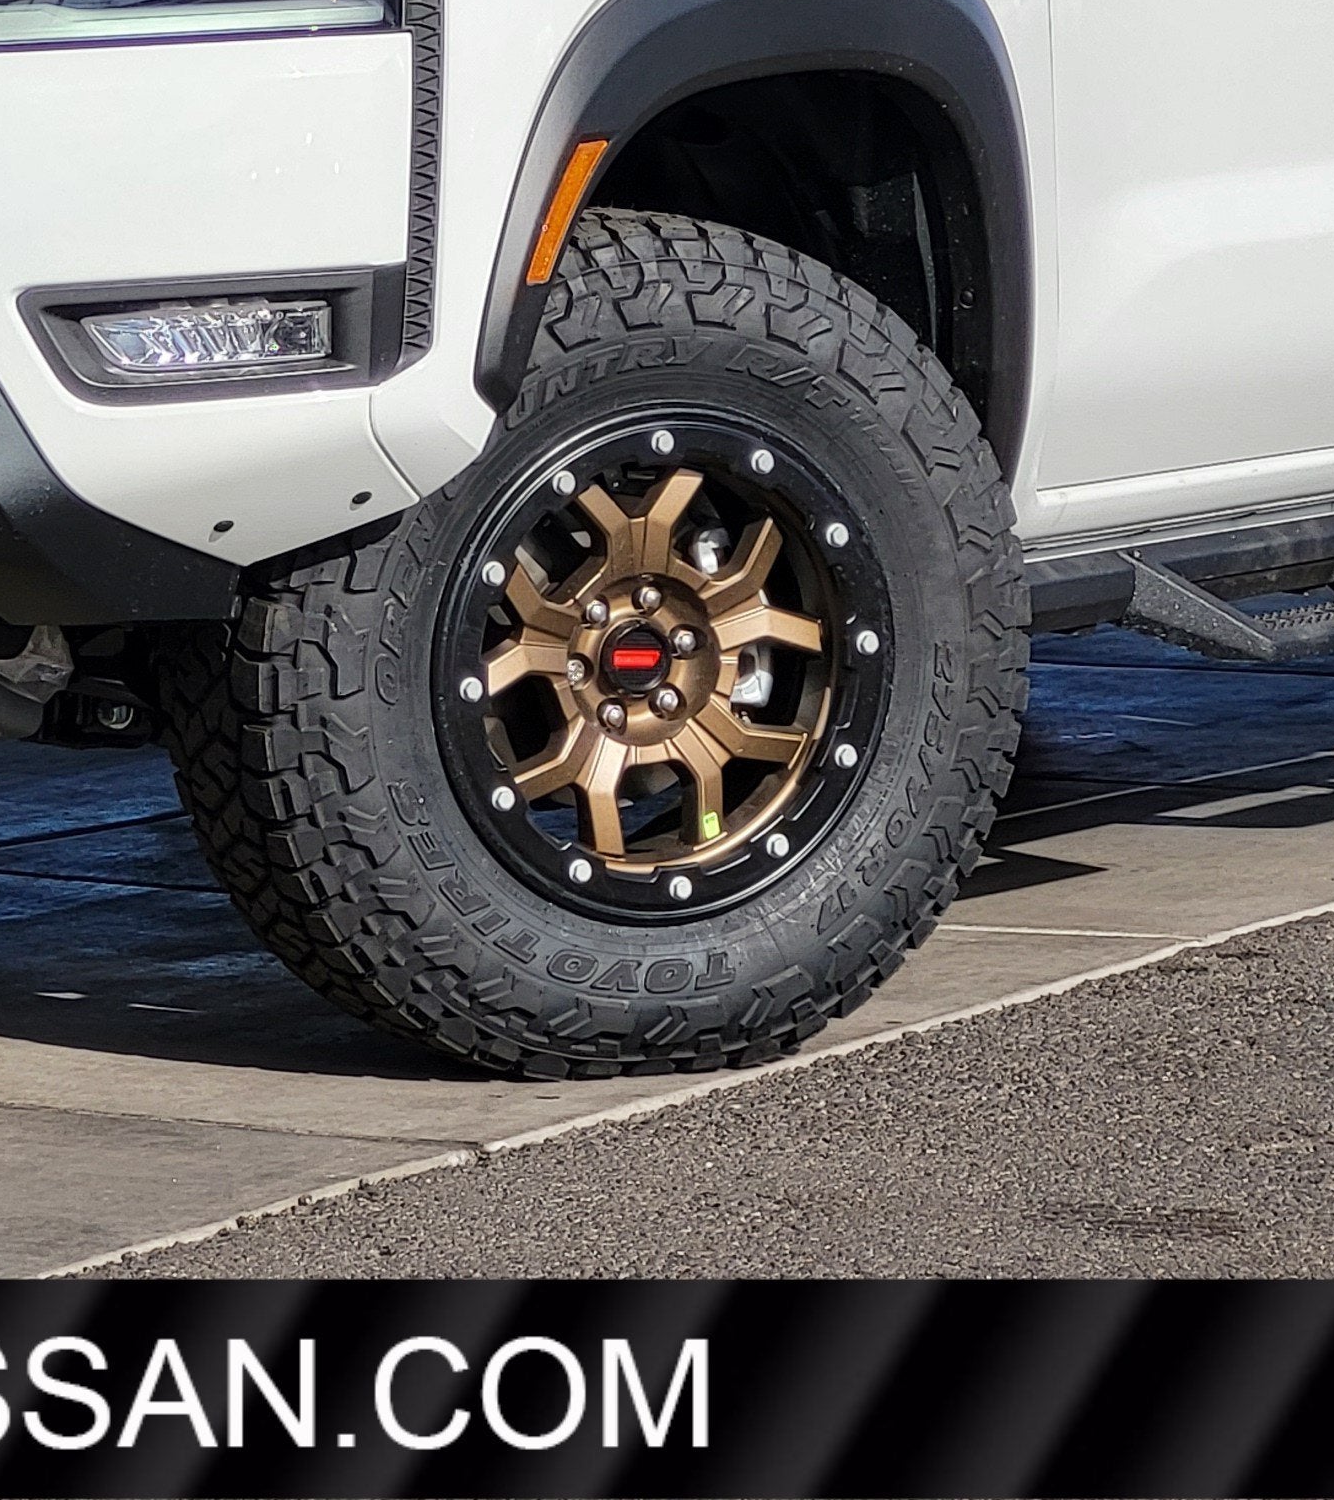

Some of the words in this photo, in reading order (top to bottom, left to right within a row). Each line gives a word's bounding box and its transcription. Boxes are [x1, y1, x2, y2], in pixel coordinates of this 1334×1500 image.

[725, 342, 851, 410] R/T
[386, 782, 541, 965] TIRES
[545, 950, 737, 994] TOYO
